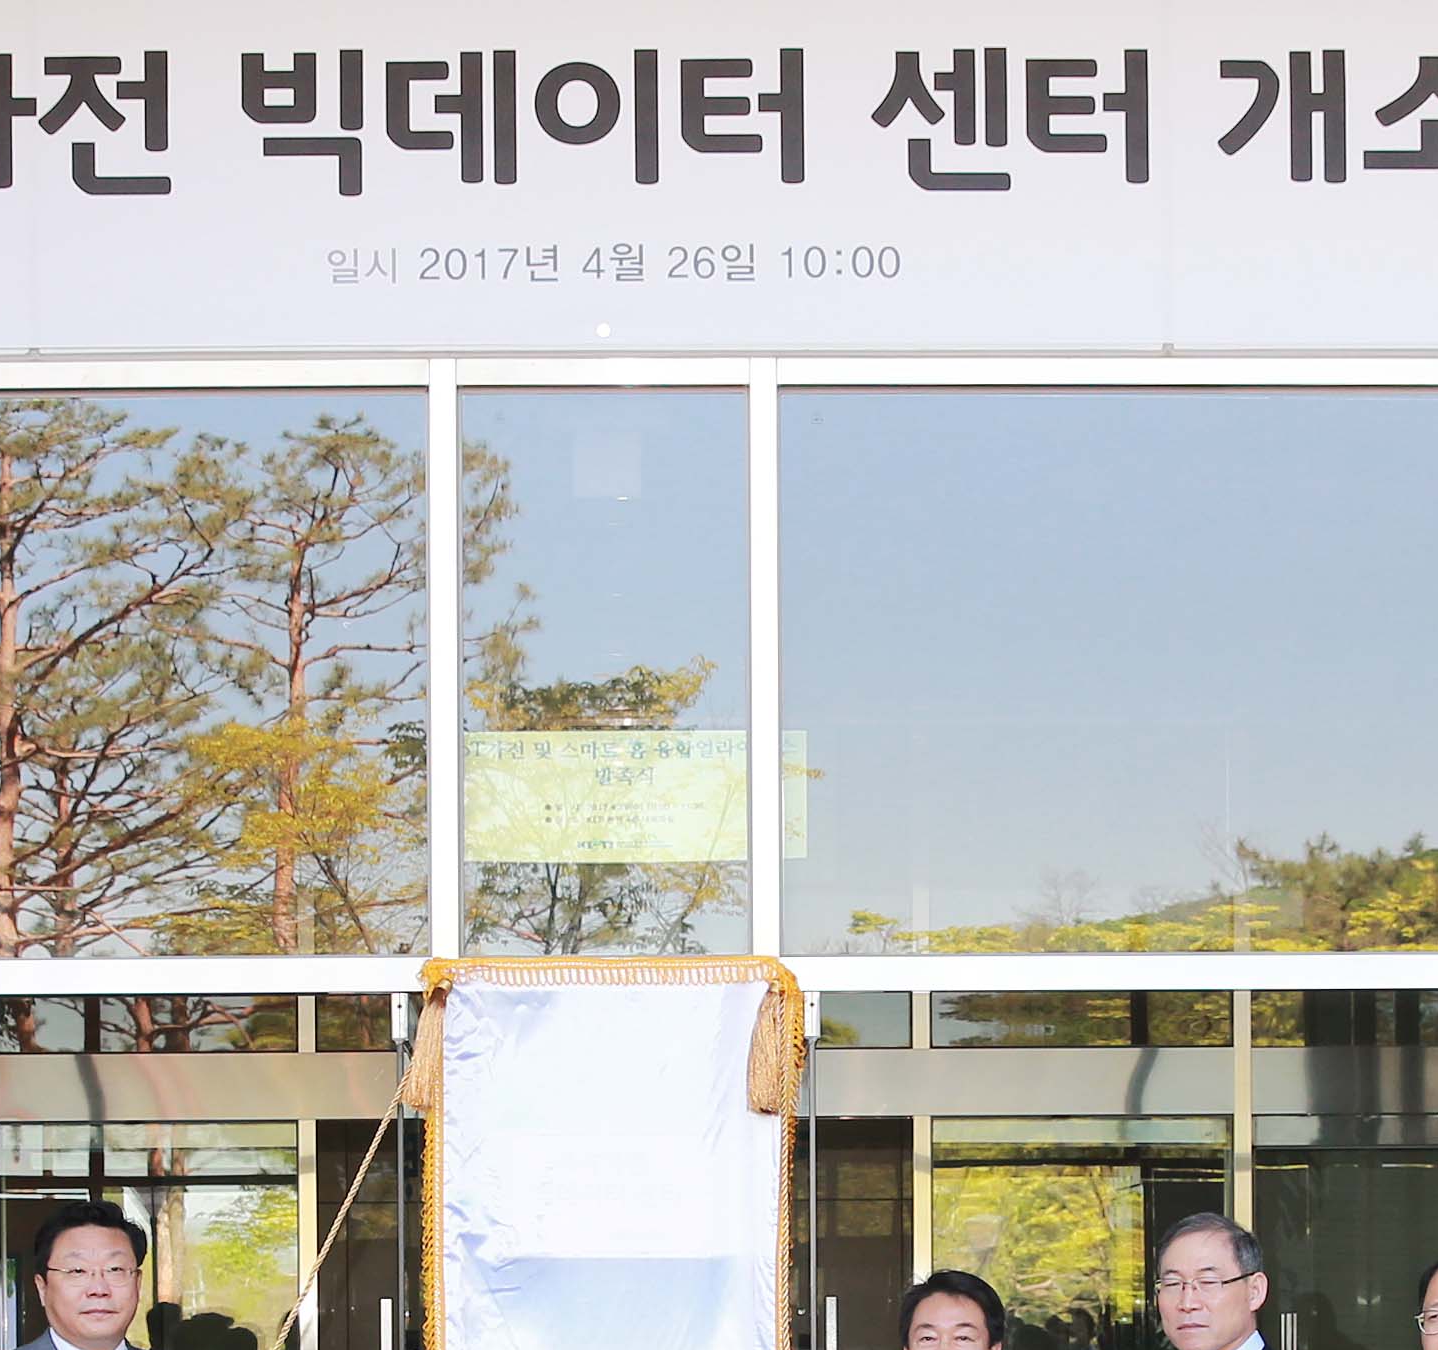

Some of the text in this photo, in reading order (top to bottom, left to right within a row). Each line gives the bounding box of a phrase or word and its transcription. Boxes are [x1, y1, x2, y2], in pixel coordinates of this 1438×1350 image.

[240, 47, 806, 197] 빅데이터
[870, 47, 1150, 191] 센터
[326, 242, 902, 285] 일시 2017년 4월 26일 10:00
